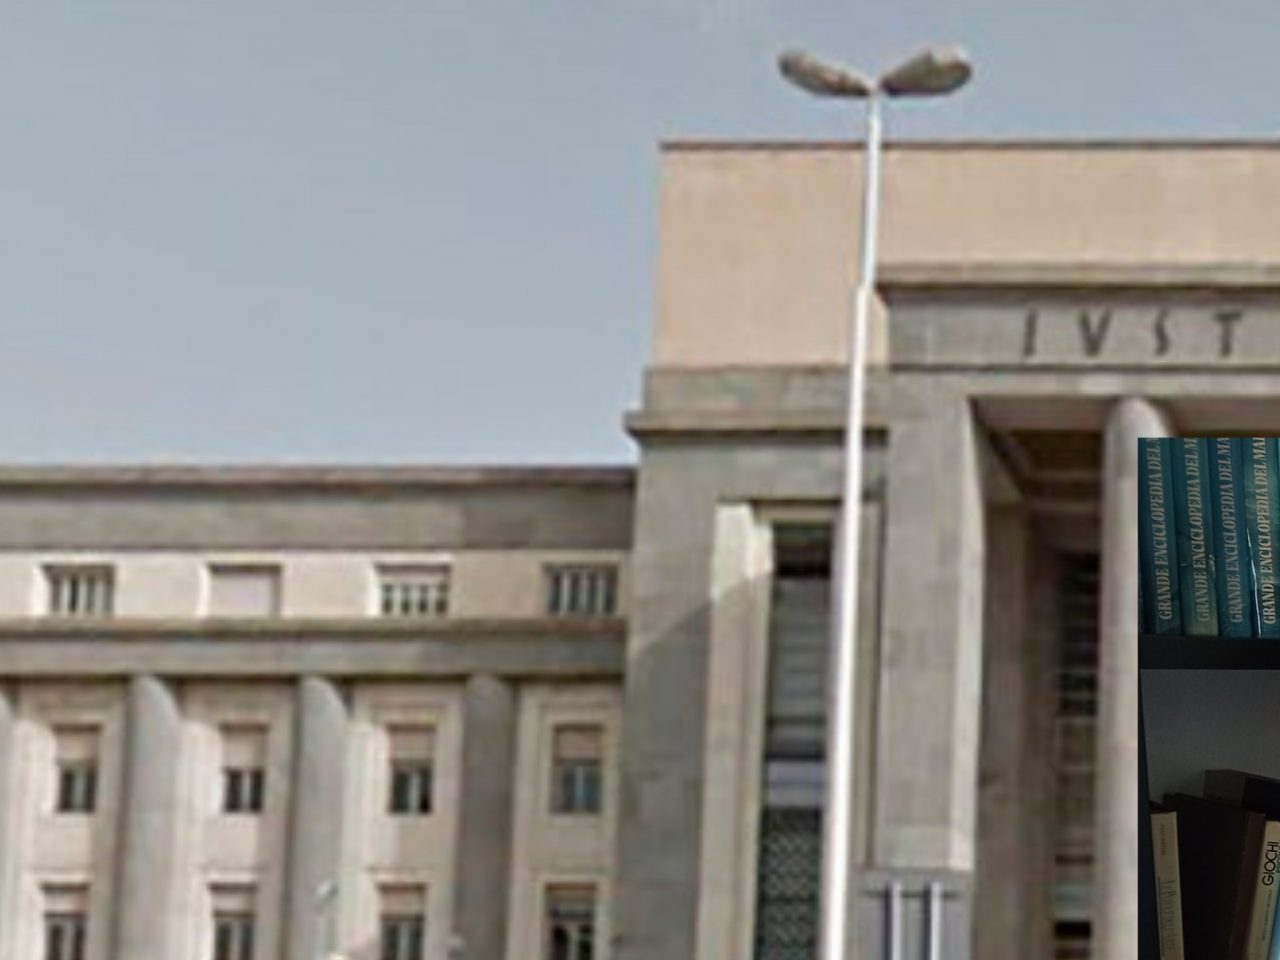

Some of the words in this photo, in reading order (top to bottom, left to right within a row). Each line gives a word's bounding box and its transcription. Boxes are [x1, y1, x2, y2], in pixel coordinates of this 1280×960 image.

[1147, 445, 1161, 473] DEL
[1185, 449, 1200, 477] DEL
[1218, 455, 1233, 481] DEL
[1254, 460, 1268, 486] DEL
[1149, 474, 1169, 564] ENCICLOPEDIA
[1187, 479, 1206, 569] ENCICLOPEDIA
[1220, 483, 1240, 571] ENCICLOPEDIA
[1256, 487, 1273, 572] ENCICLOPEDIA
[1157, 566, 1172, 620] GRANDE
[1195, 570, 1210, 621] GRANDE
[1228, 573, 1243, 623] GRANDE
[1262, 574, 1276, 624] GRANDE
[1261, 841, 1280, 887] GIOCHI
